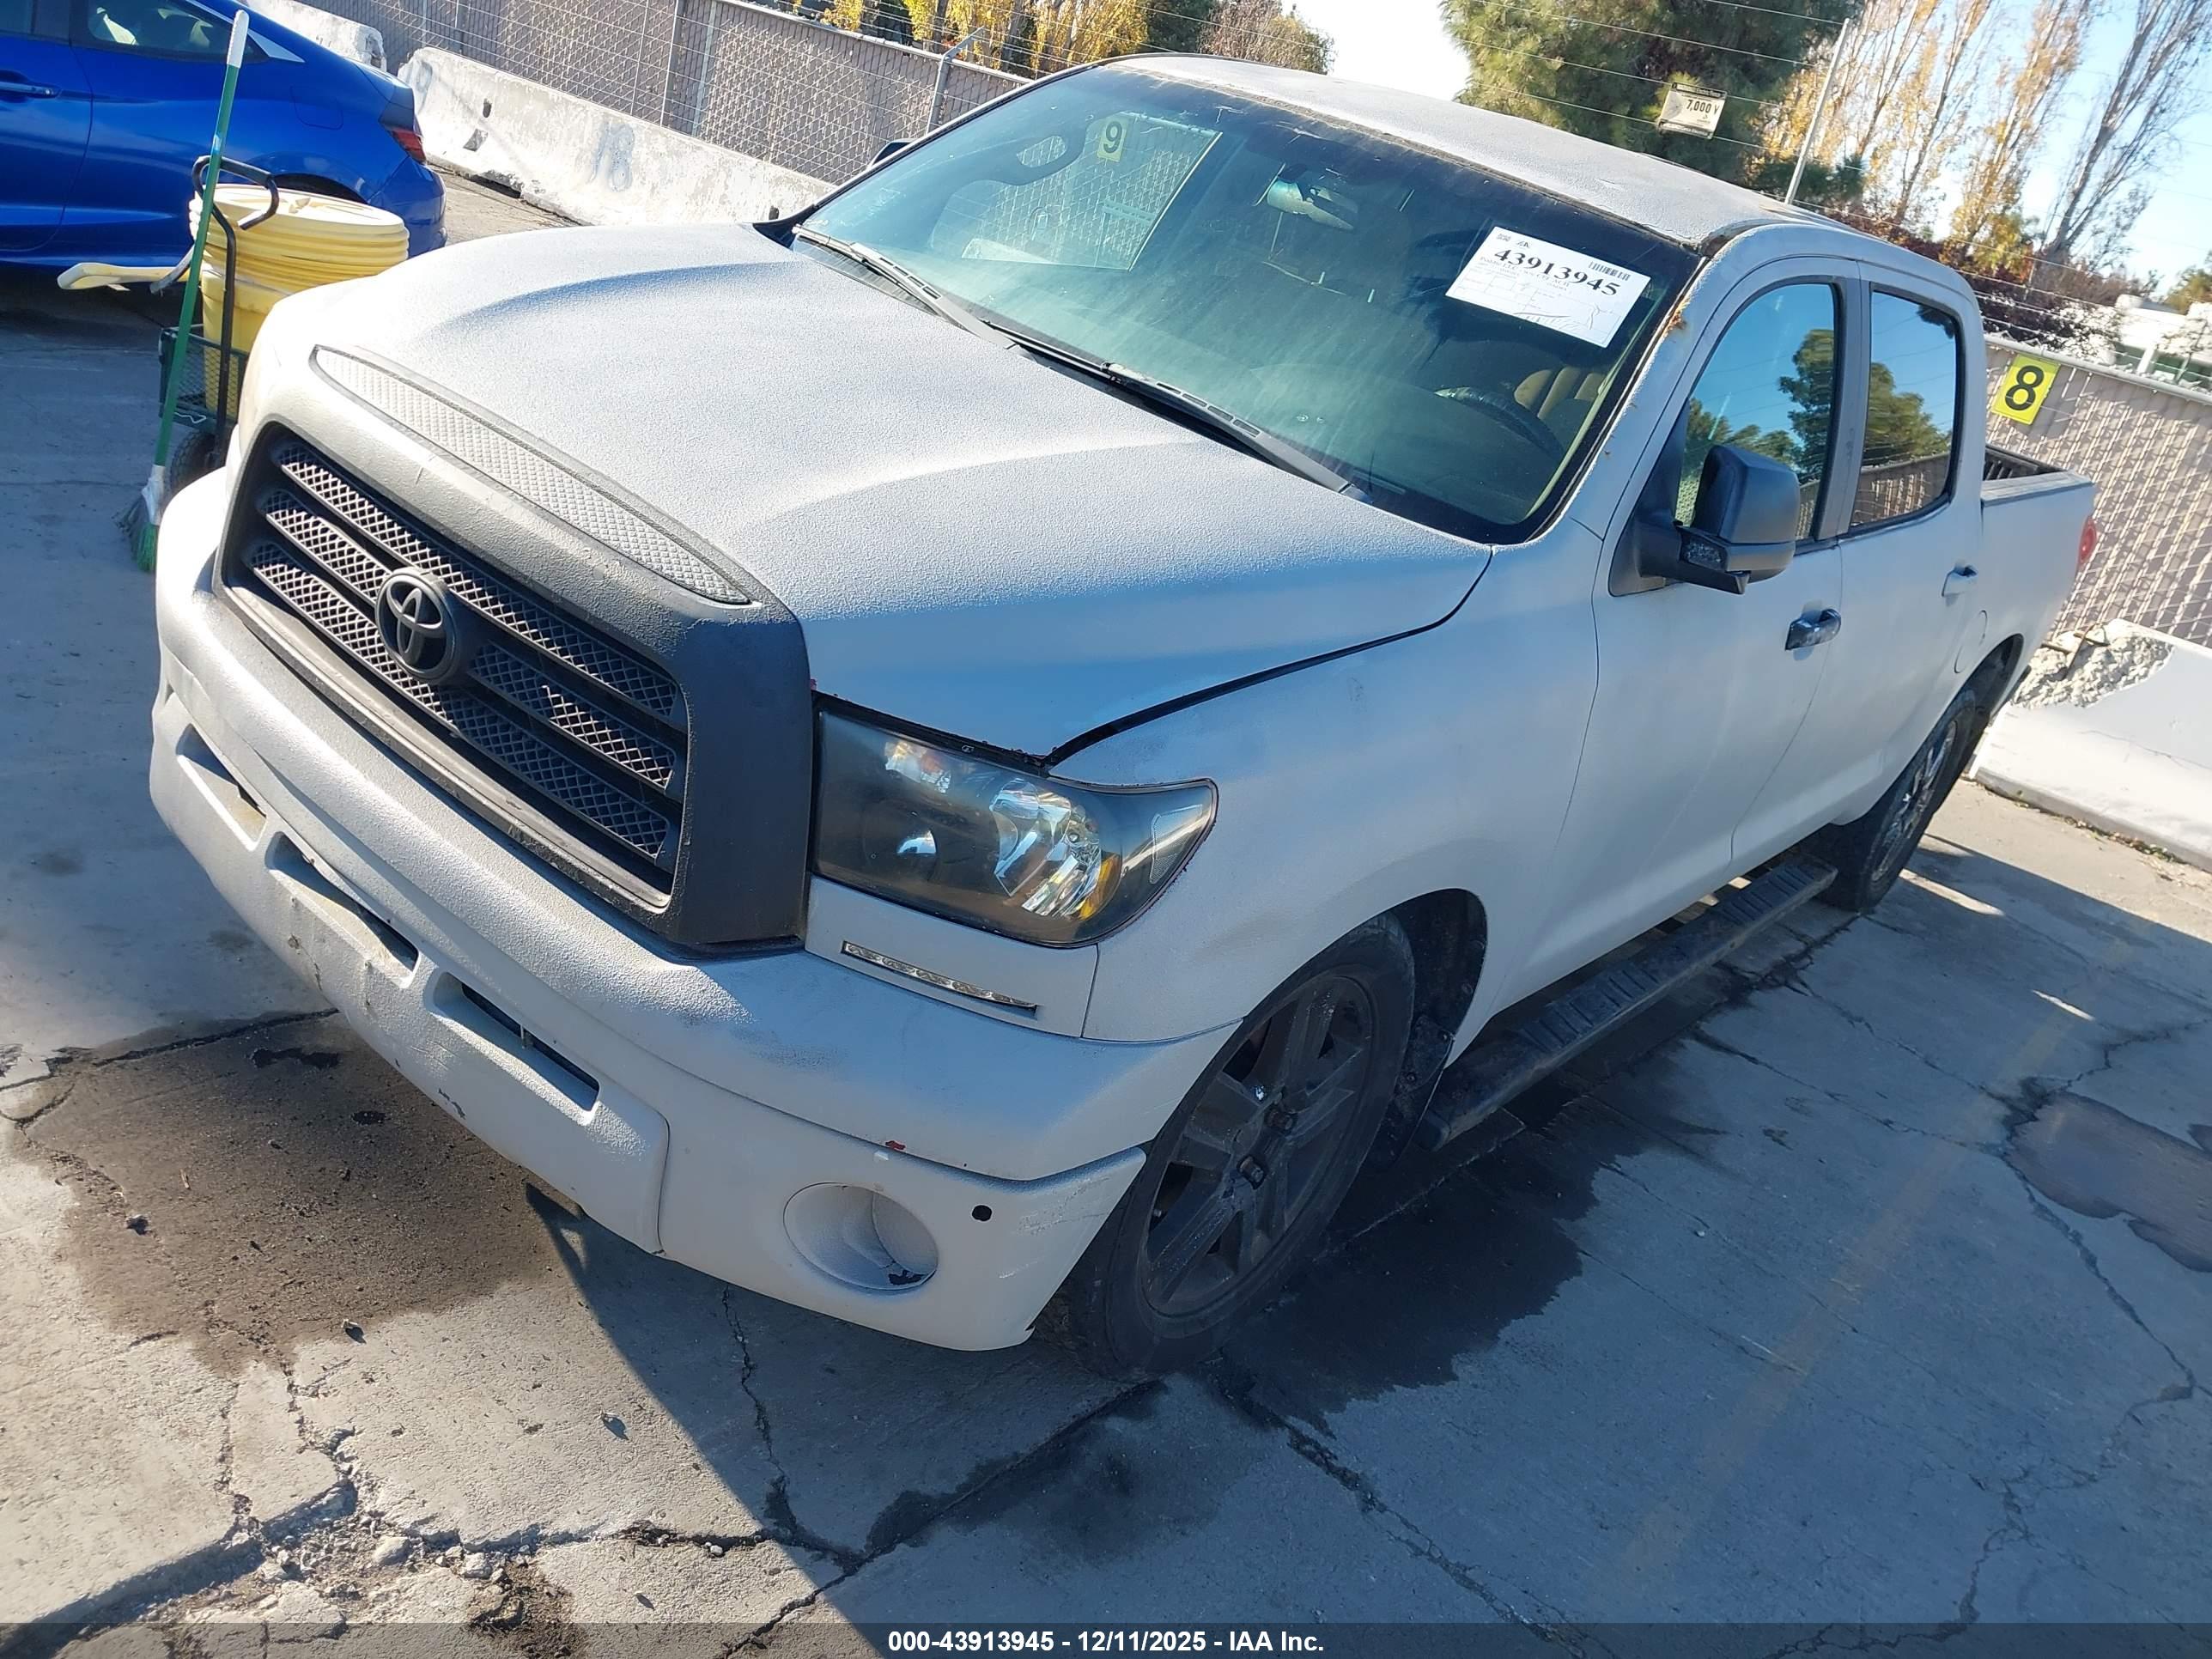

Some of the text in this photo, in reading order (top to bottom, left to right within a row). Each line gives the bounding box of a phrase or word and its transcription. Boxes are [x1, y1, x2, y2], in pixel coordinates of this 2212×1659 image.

[1686, 99, 1712, 113] 7,000
[1103, 121, 1123, 154] 9
[1493, 249, 1621, 296] 43913945
[2005, 365, 2045, 410] 8
